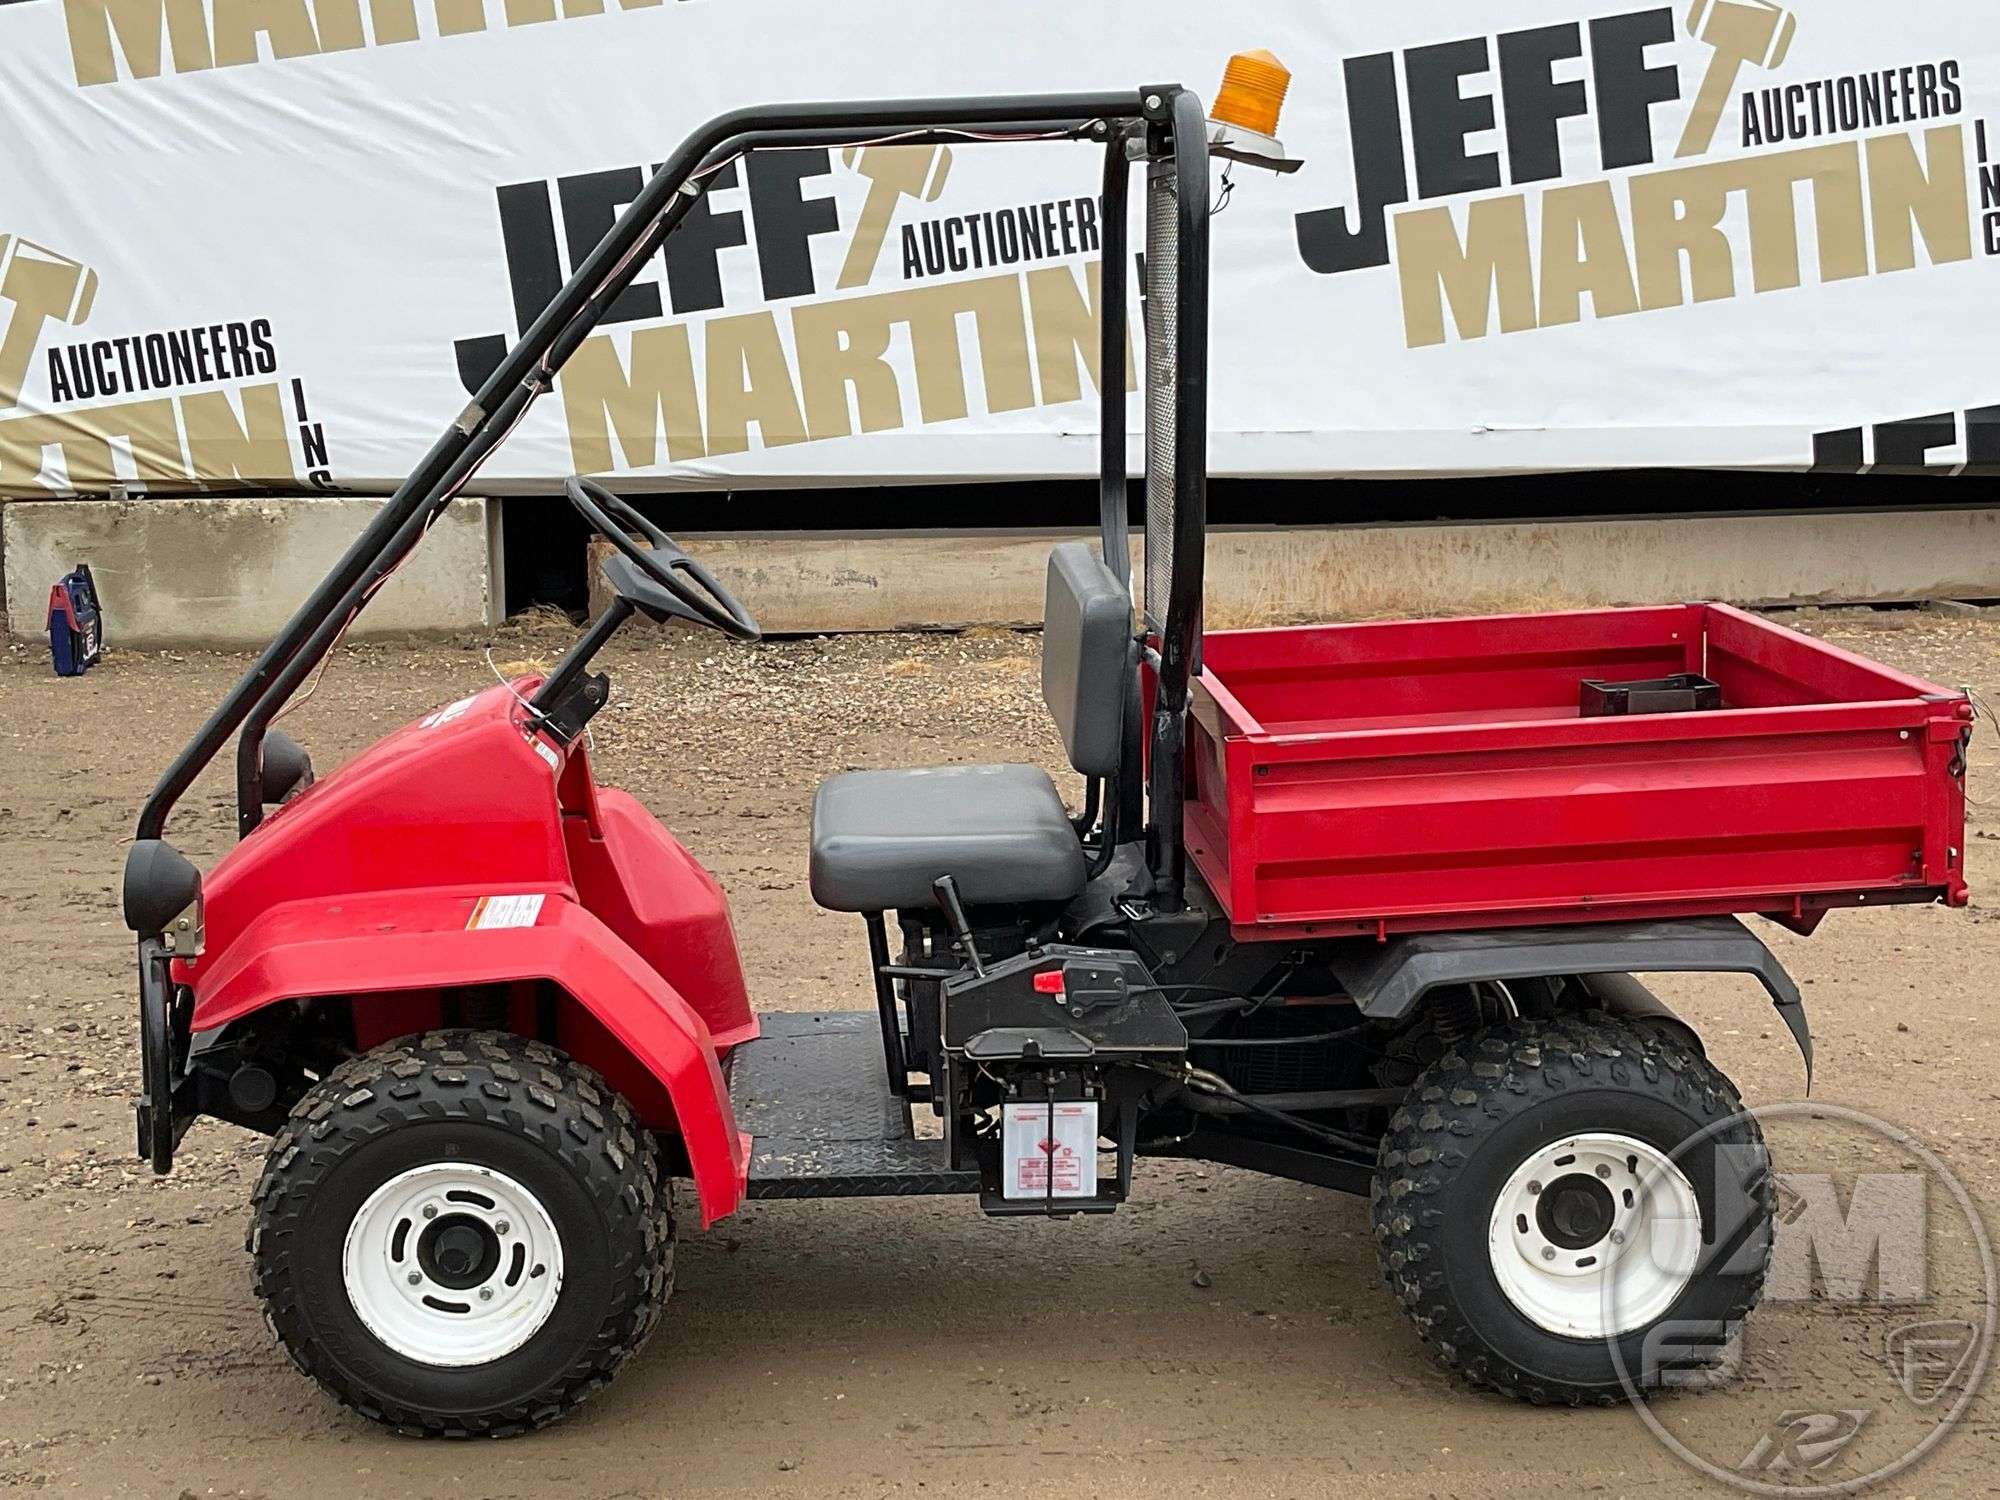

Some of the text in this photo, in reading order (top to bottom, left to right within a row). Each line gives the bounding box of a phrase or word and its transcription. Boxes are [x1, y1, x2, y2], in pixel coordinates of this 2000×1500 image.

[1295, 6, 1680, 275] JEFF
[1741, 59, 1963, 148] AUCTIONEERS
[454, 147, 840, 395] JEFF
[900, 196, 1104, 280] AUCTIONEER
[1393, 123, 1972, 349] MARTIN
[47, 318, 277, 403] AUCTIONEERS
[558, 261, 1138, 475] MARTIN
